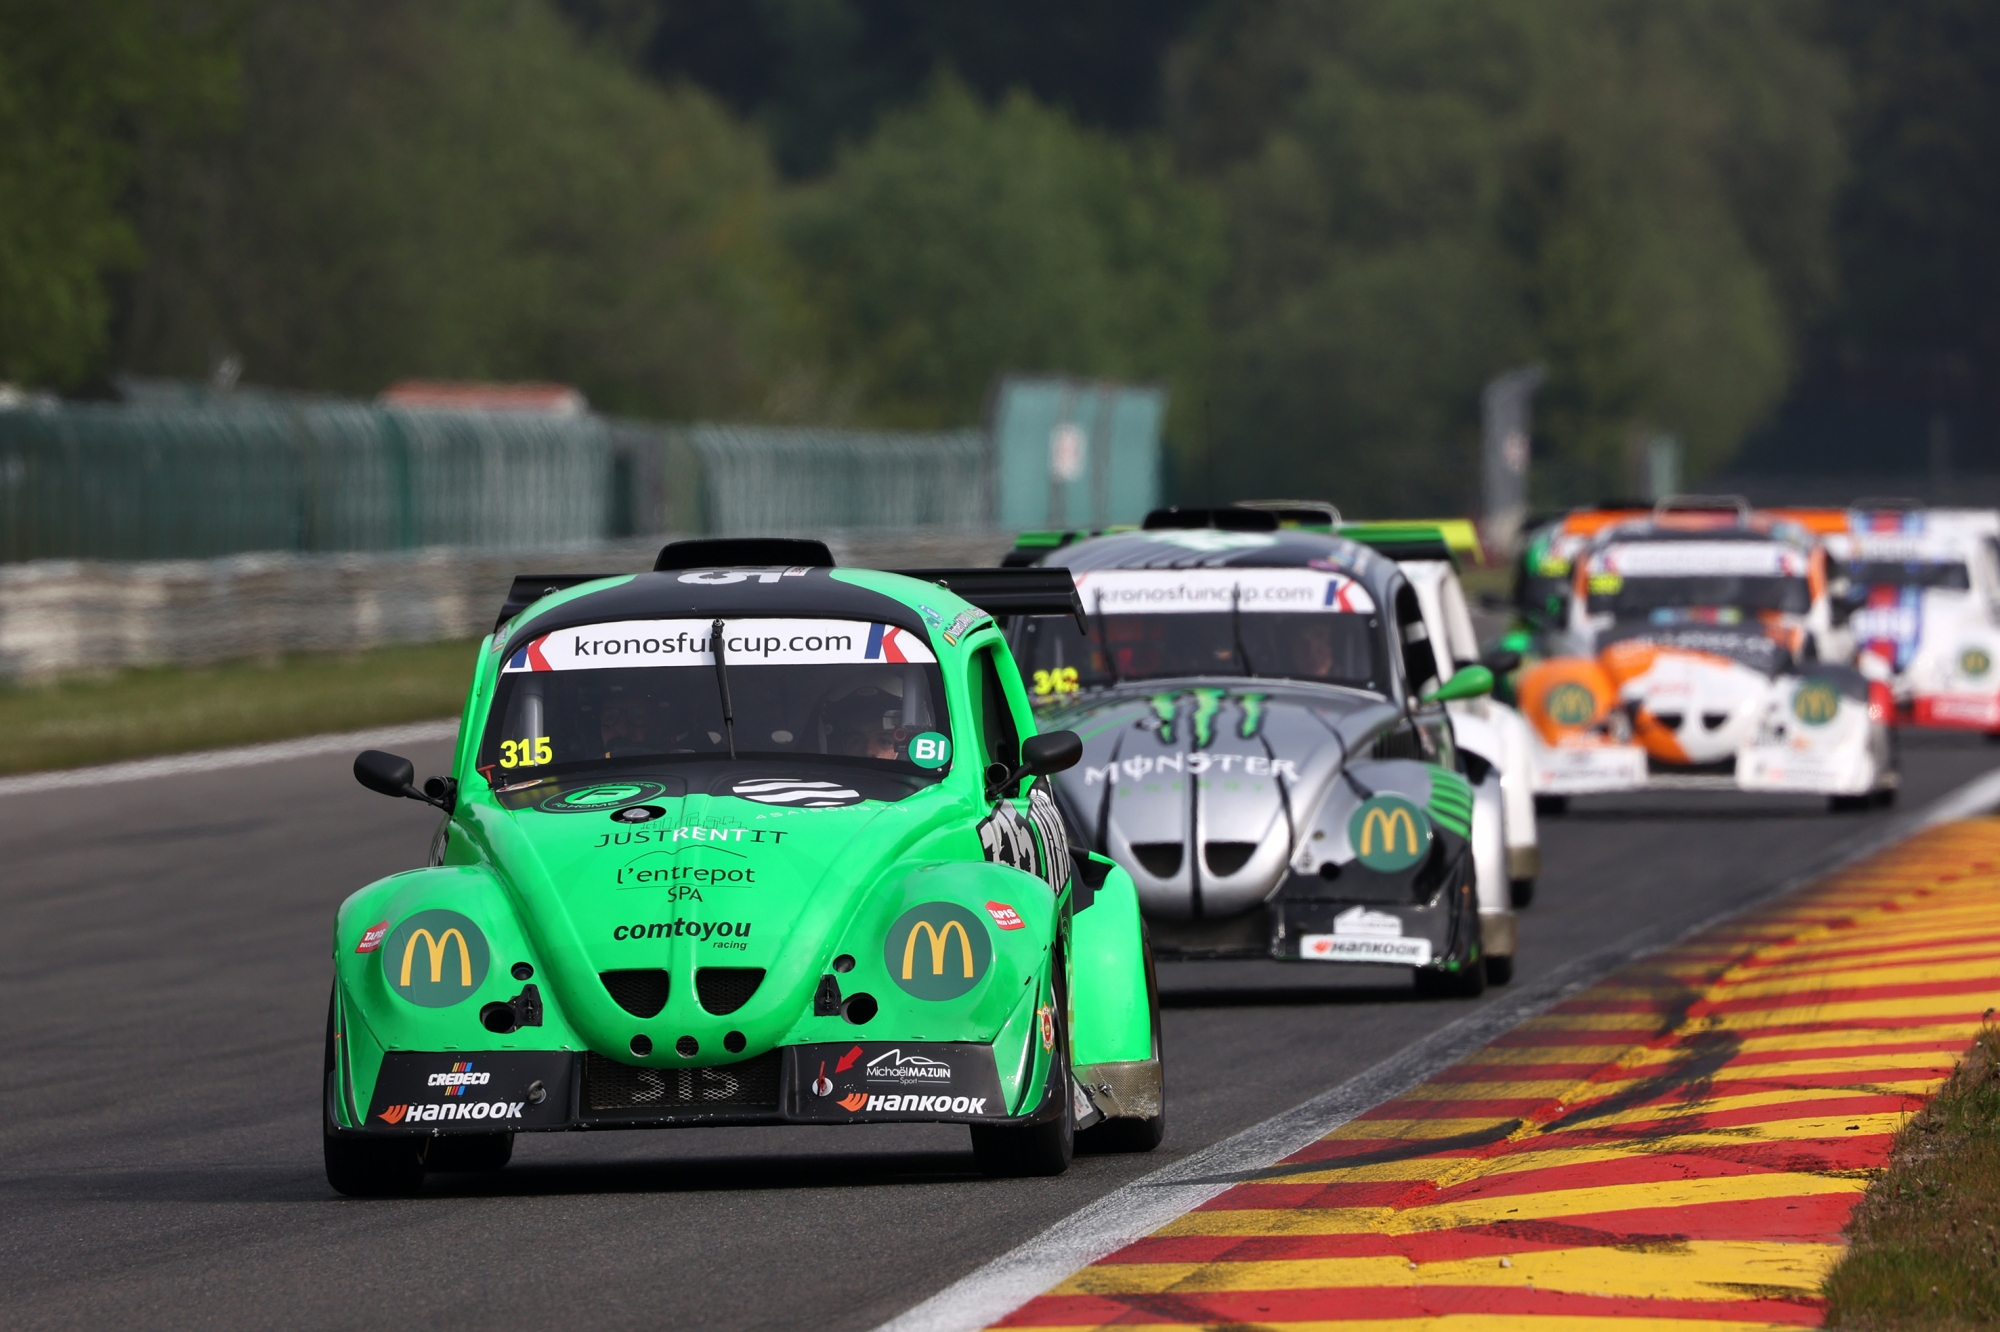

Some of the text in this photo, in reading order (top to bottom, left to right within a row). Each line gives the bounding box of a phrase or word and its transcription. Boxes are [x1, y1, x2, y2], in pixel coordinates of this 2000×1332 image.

[499, 737, 553, 769] 315
[1084, 751, 1299, 785] MONSTER
[667, 885, 703, 903] SPA
[987, 908, 1017, 919] TAPIS
[613, 917, 751, 942] comtoyou
[713, 941, 748, 951] racing
[427, 1071, 491, 1087] CREDECO
[900, 1077, 918, 1085] Sport
